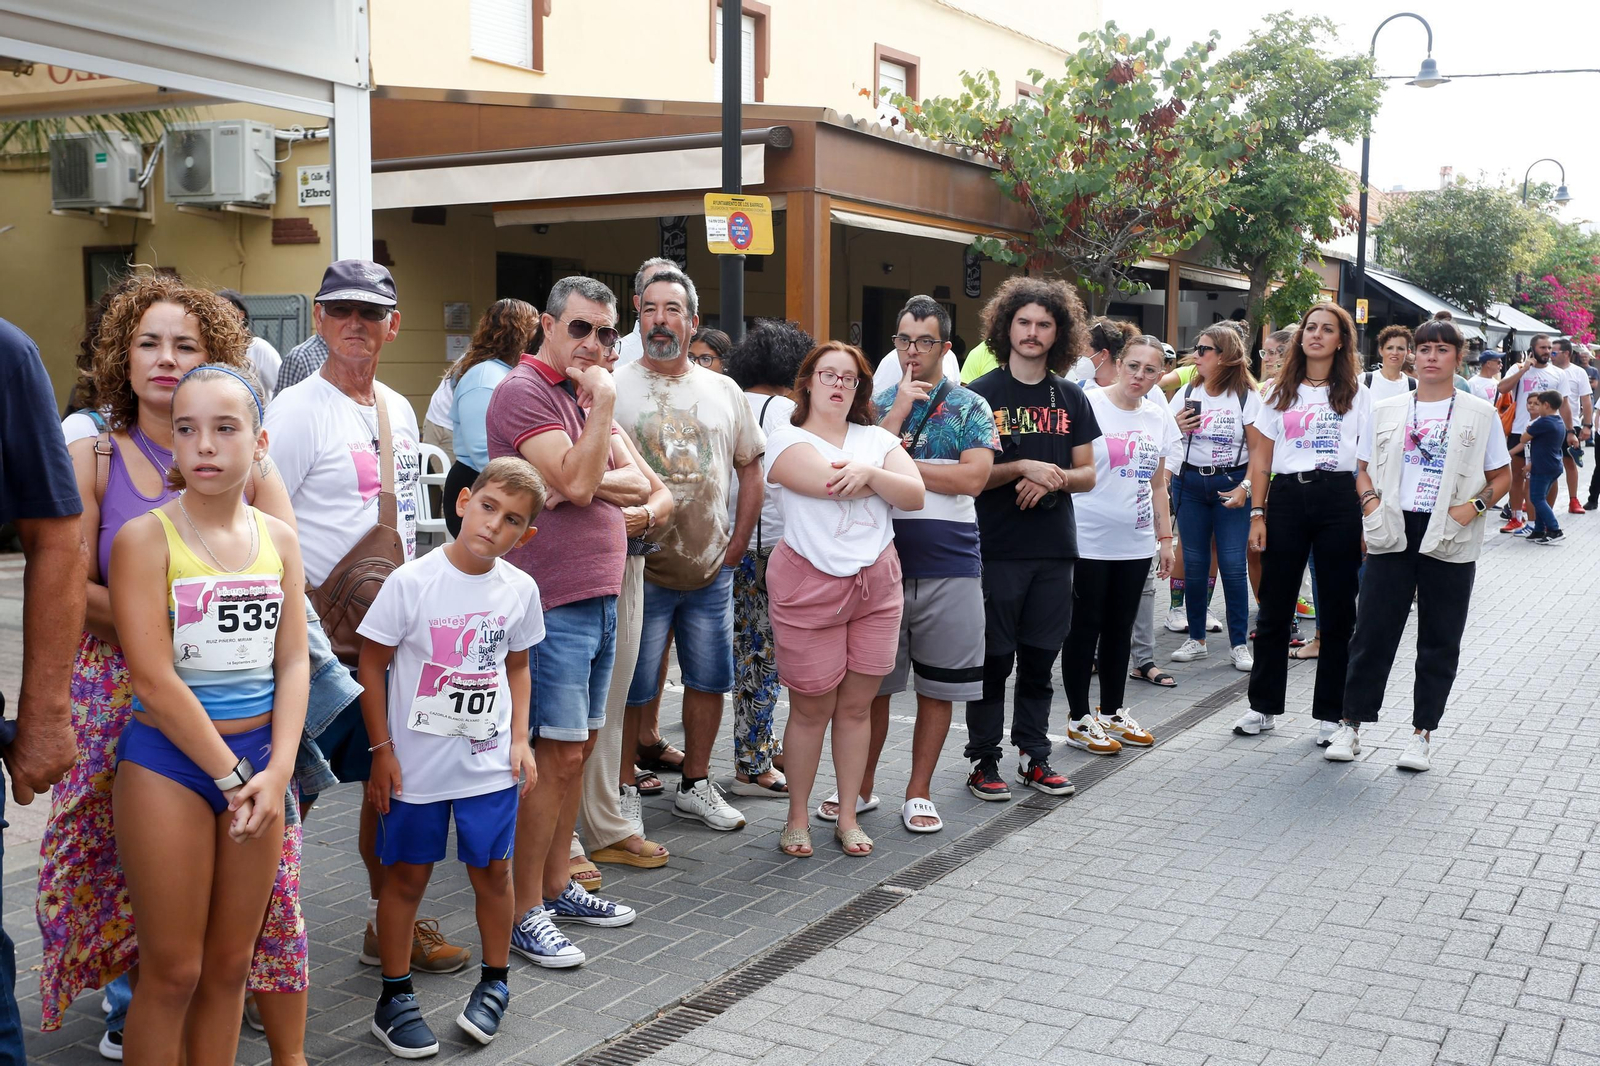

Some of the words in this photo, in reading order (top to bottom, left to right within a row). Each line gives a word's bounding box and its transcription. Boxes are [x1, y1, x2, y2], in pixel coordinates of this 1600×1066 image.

[305, 188, 331, 198] Ebro
[1295, 440, 1339, 449] SONRISA
[217, 601, 280, 634] 533
[448, 691, 497, 715] 107
